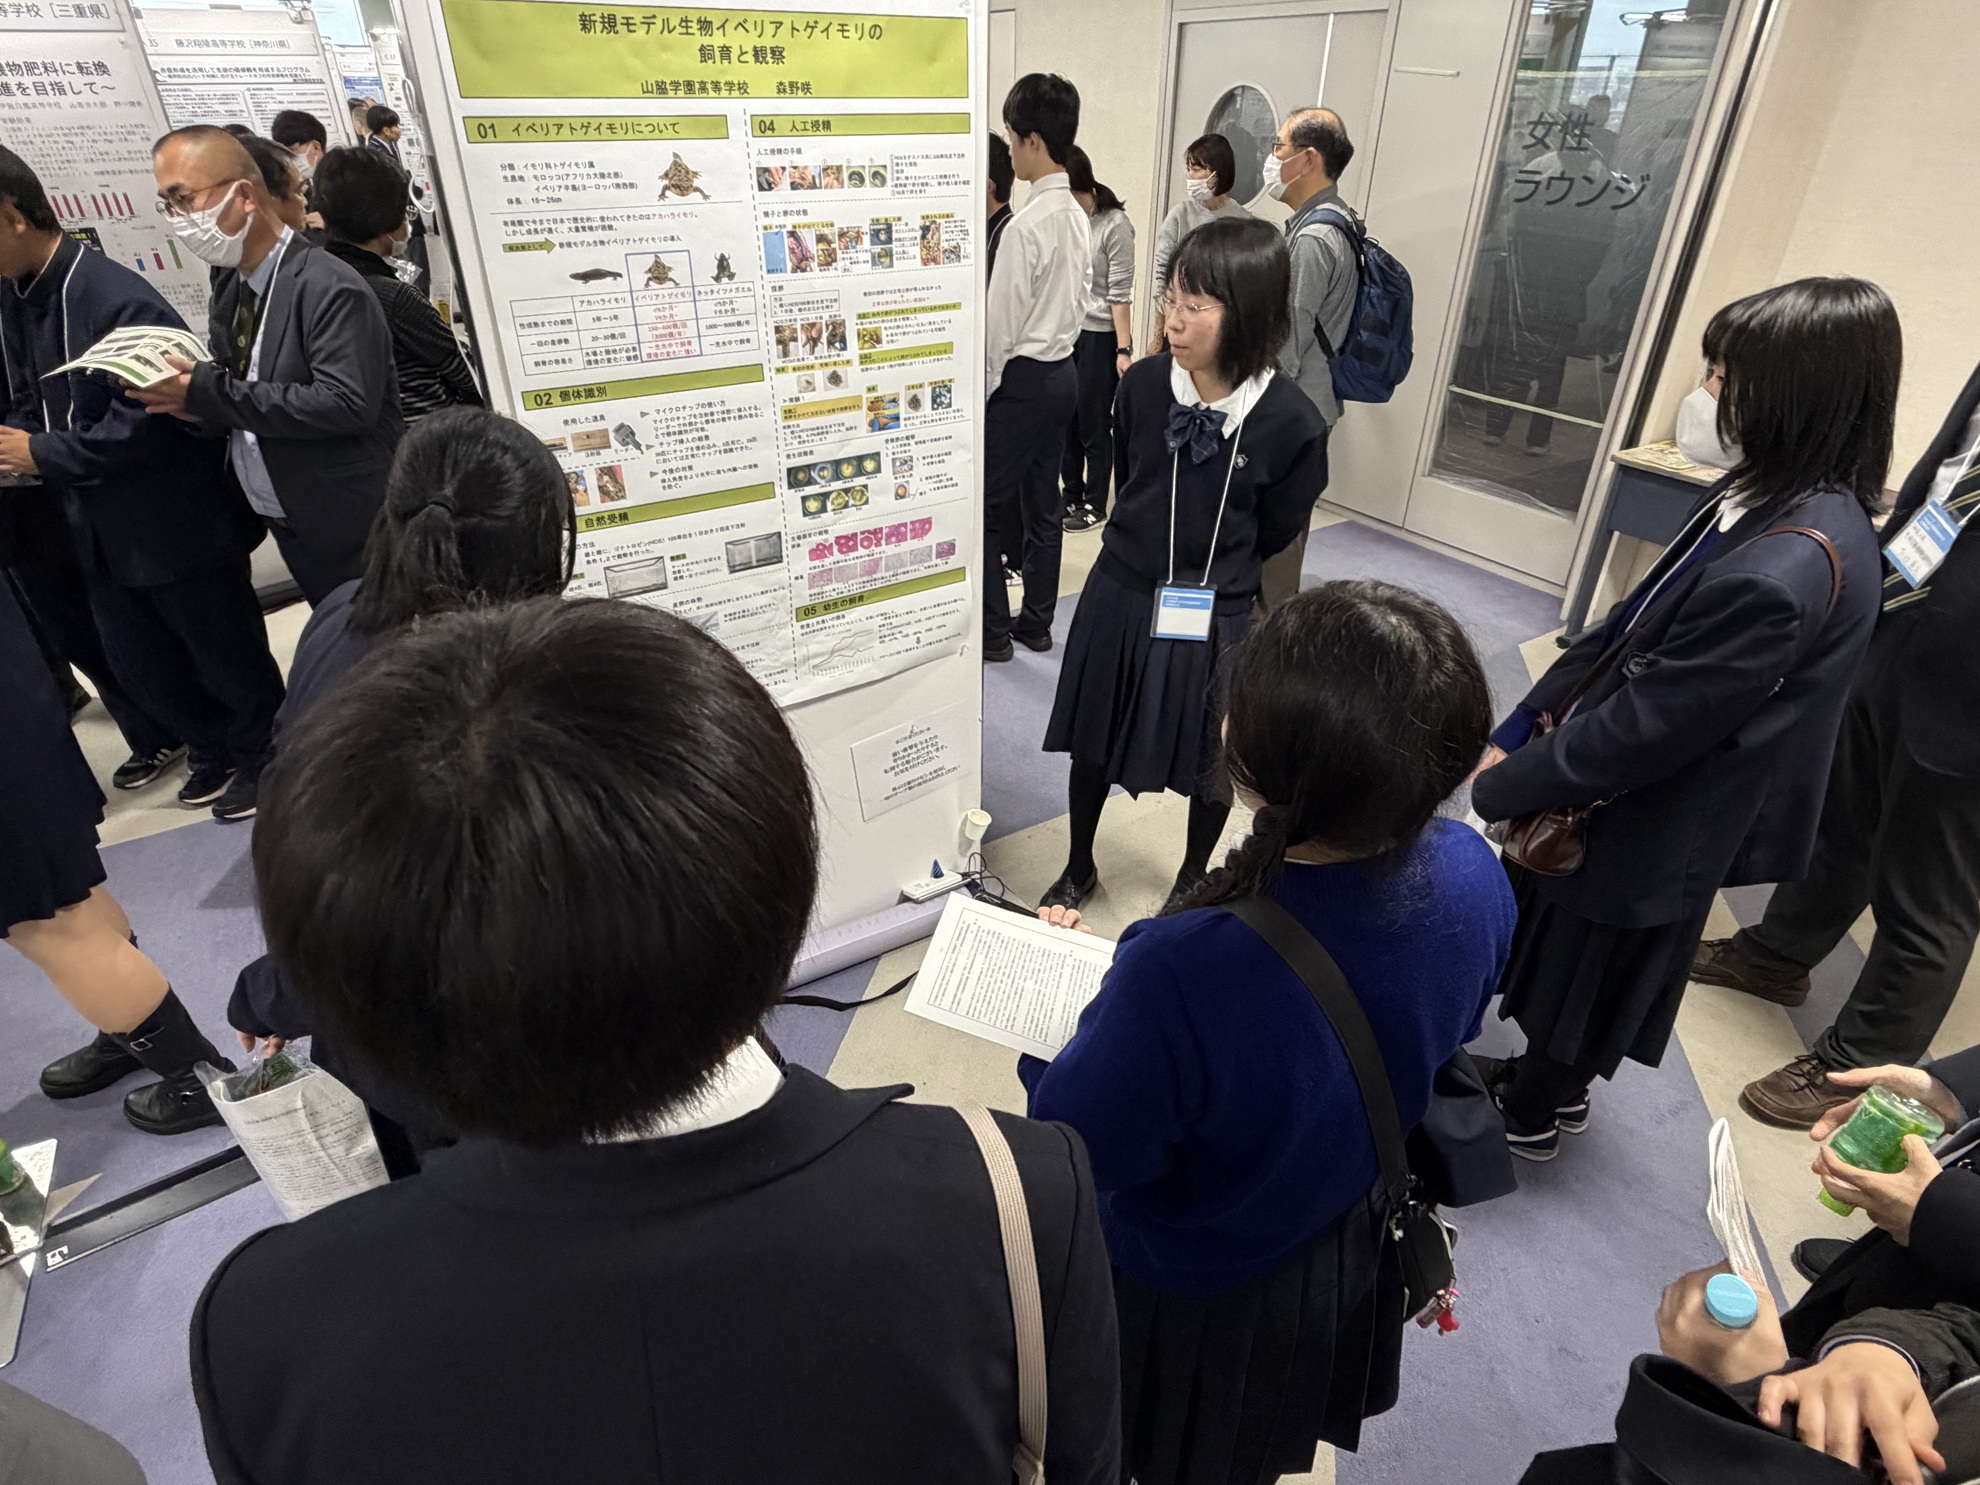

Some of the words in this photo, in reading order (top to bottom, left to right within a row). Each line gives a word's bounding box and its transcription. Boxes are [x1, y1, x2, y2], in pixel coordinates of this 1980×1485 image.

[578, 11, 884, 41] 新規モデル生物イベリアトゲイモリの
[698, 43, 786, 66] 飼育と観察
[641, 79, 750, 96] 山脇学園高等学校
[775, 80, 813, 96] 森野咲
[477, 122, 498, 140] 01
[510, 121, 681, 136] イベリアトゲイモリについて
[759, 119, 776, 134] 04
[789, 119, 832, 133] 人工授精
[1522, 111, 1595, 151] 女性
[1513, 170, 1651, 210] ラウンジ
[578, 296, 627, 307] アカハライモリ
[634, 290, 692, 302] イベリアトゲイモリ
[534, 392, 554, 407] 02
[559, 386, 608, 402] 個体識別
[584, 511, 630, 529] 自然受精
[803, 606, 817, 617] 05
[823, 594, 866, 612] 幼生の飼育
